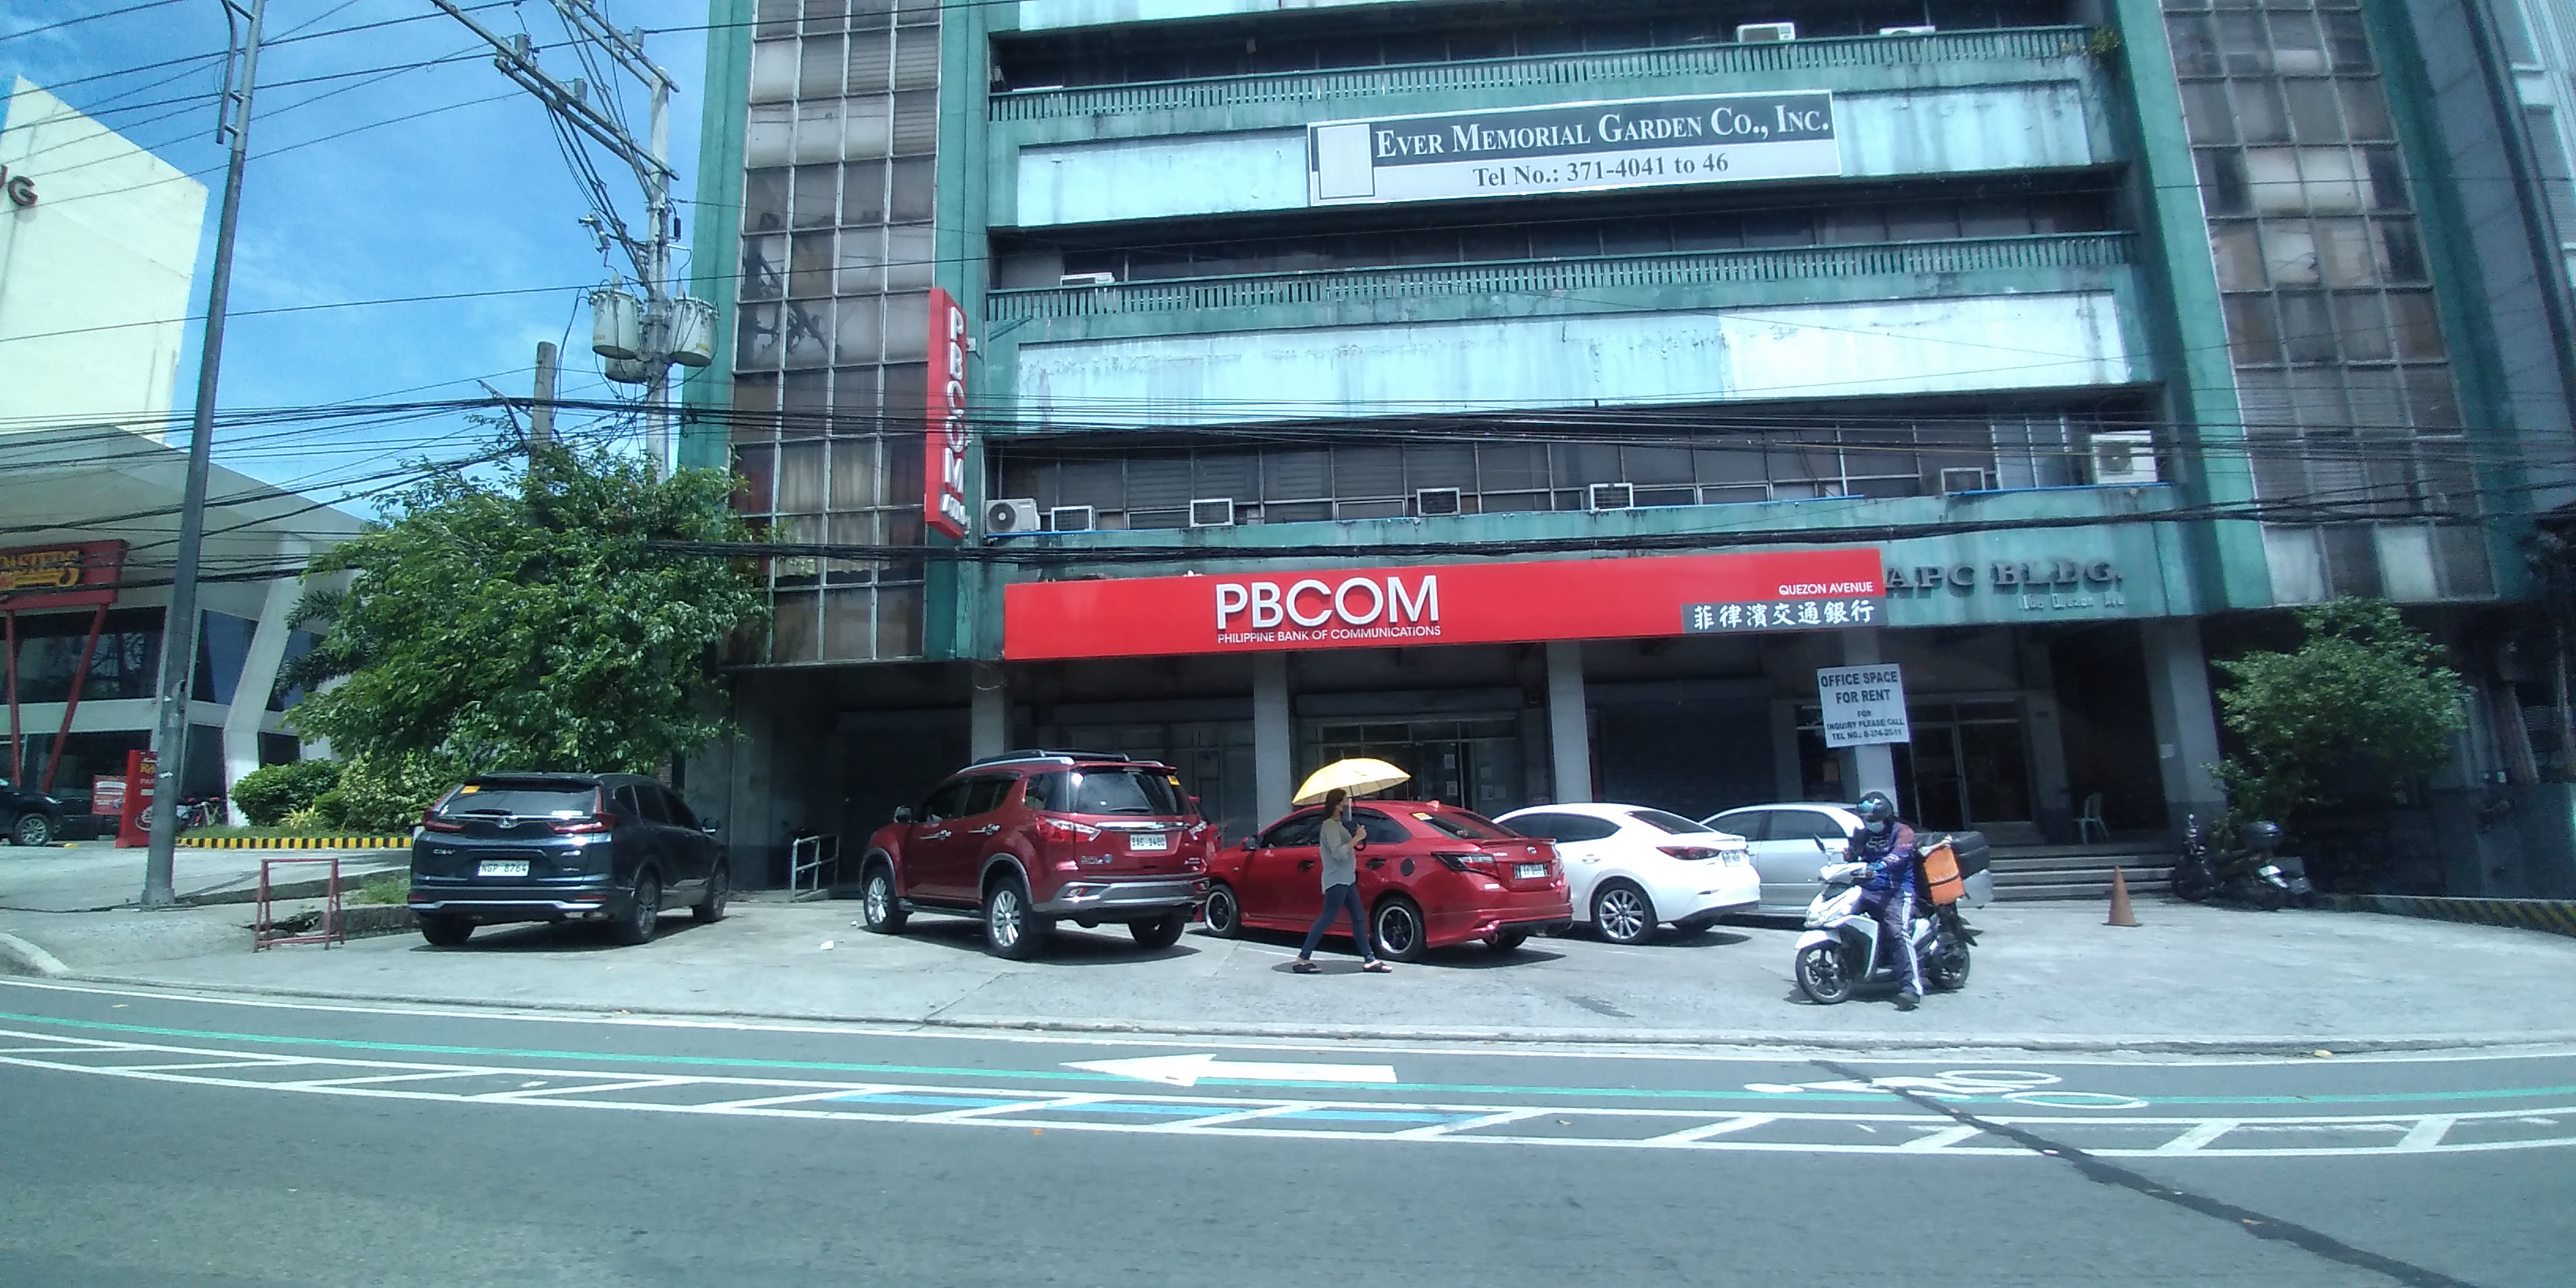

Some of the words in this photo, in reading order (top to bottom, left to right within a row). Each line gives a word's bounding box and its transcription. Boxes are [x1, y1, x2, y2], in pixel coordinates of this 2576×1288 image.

[1376, 127, 1443, 159] EVER
[1451, 121, 1590, 153] MEMORIAL
[1598, 113, 1702, 144] GARDEN
[1776, 104, 1829, 133] INC.
[1473, 166, 1507, 188] Tel
[1514, 162, 1559, 185] No.:
[1566, 154, 1665, 182] 371-4041
[1674, 155, 1695, 175] to
[1702, 152, 1728, 174] 46
[942, 306, 964, 494] PBCOM
[1778, 583, 1826, 596] QUEZON
[1829, 581, 1874, 593] AVENUE
[1885, 564, 1976, 594] APC
[1216, 575, 1439, 630] PBCOM
[1693, 599, 1874, 631] 菲律濱交通銀行
[1218, 631, 1275, 644] PHILIPPINE
[1278, 630, 1309, 642] BANK
[1312, 629, 1327, 640] OF
[1332, 625, 1441, 639] COMMUNICATIONS
[1821, 673, 1859, 687] OFFICE
[1863, 671, 1898, 684] SPACE
[1836, 691, 1859, 704] FOR
[1862, 689, 1891, 702] RENT
[1826, 721, 1856, 731] INQUIRY
[1858, 718, 1885, 728] PLEASE
